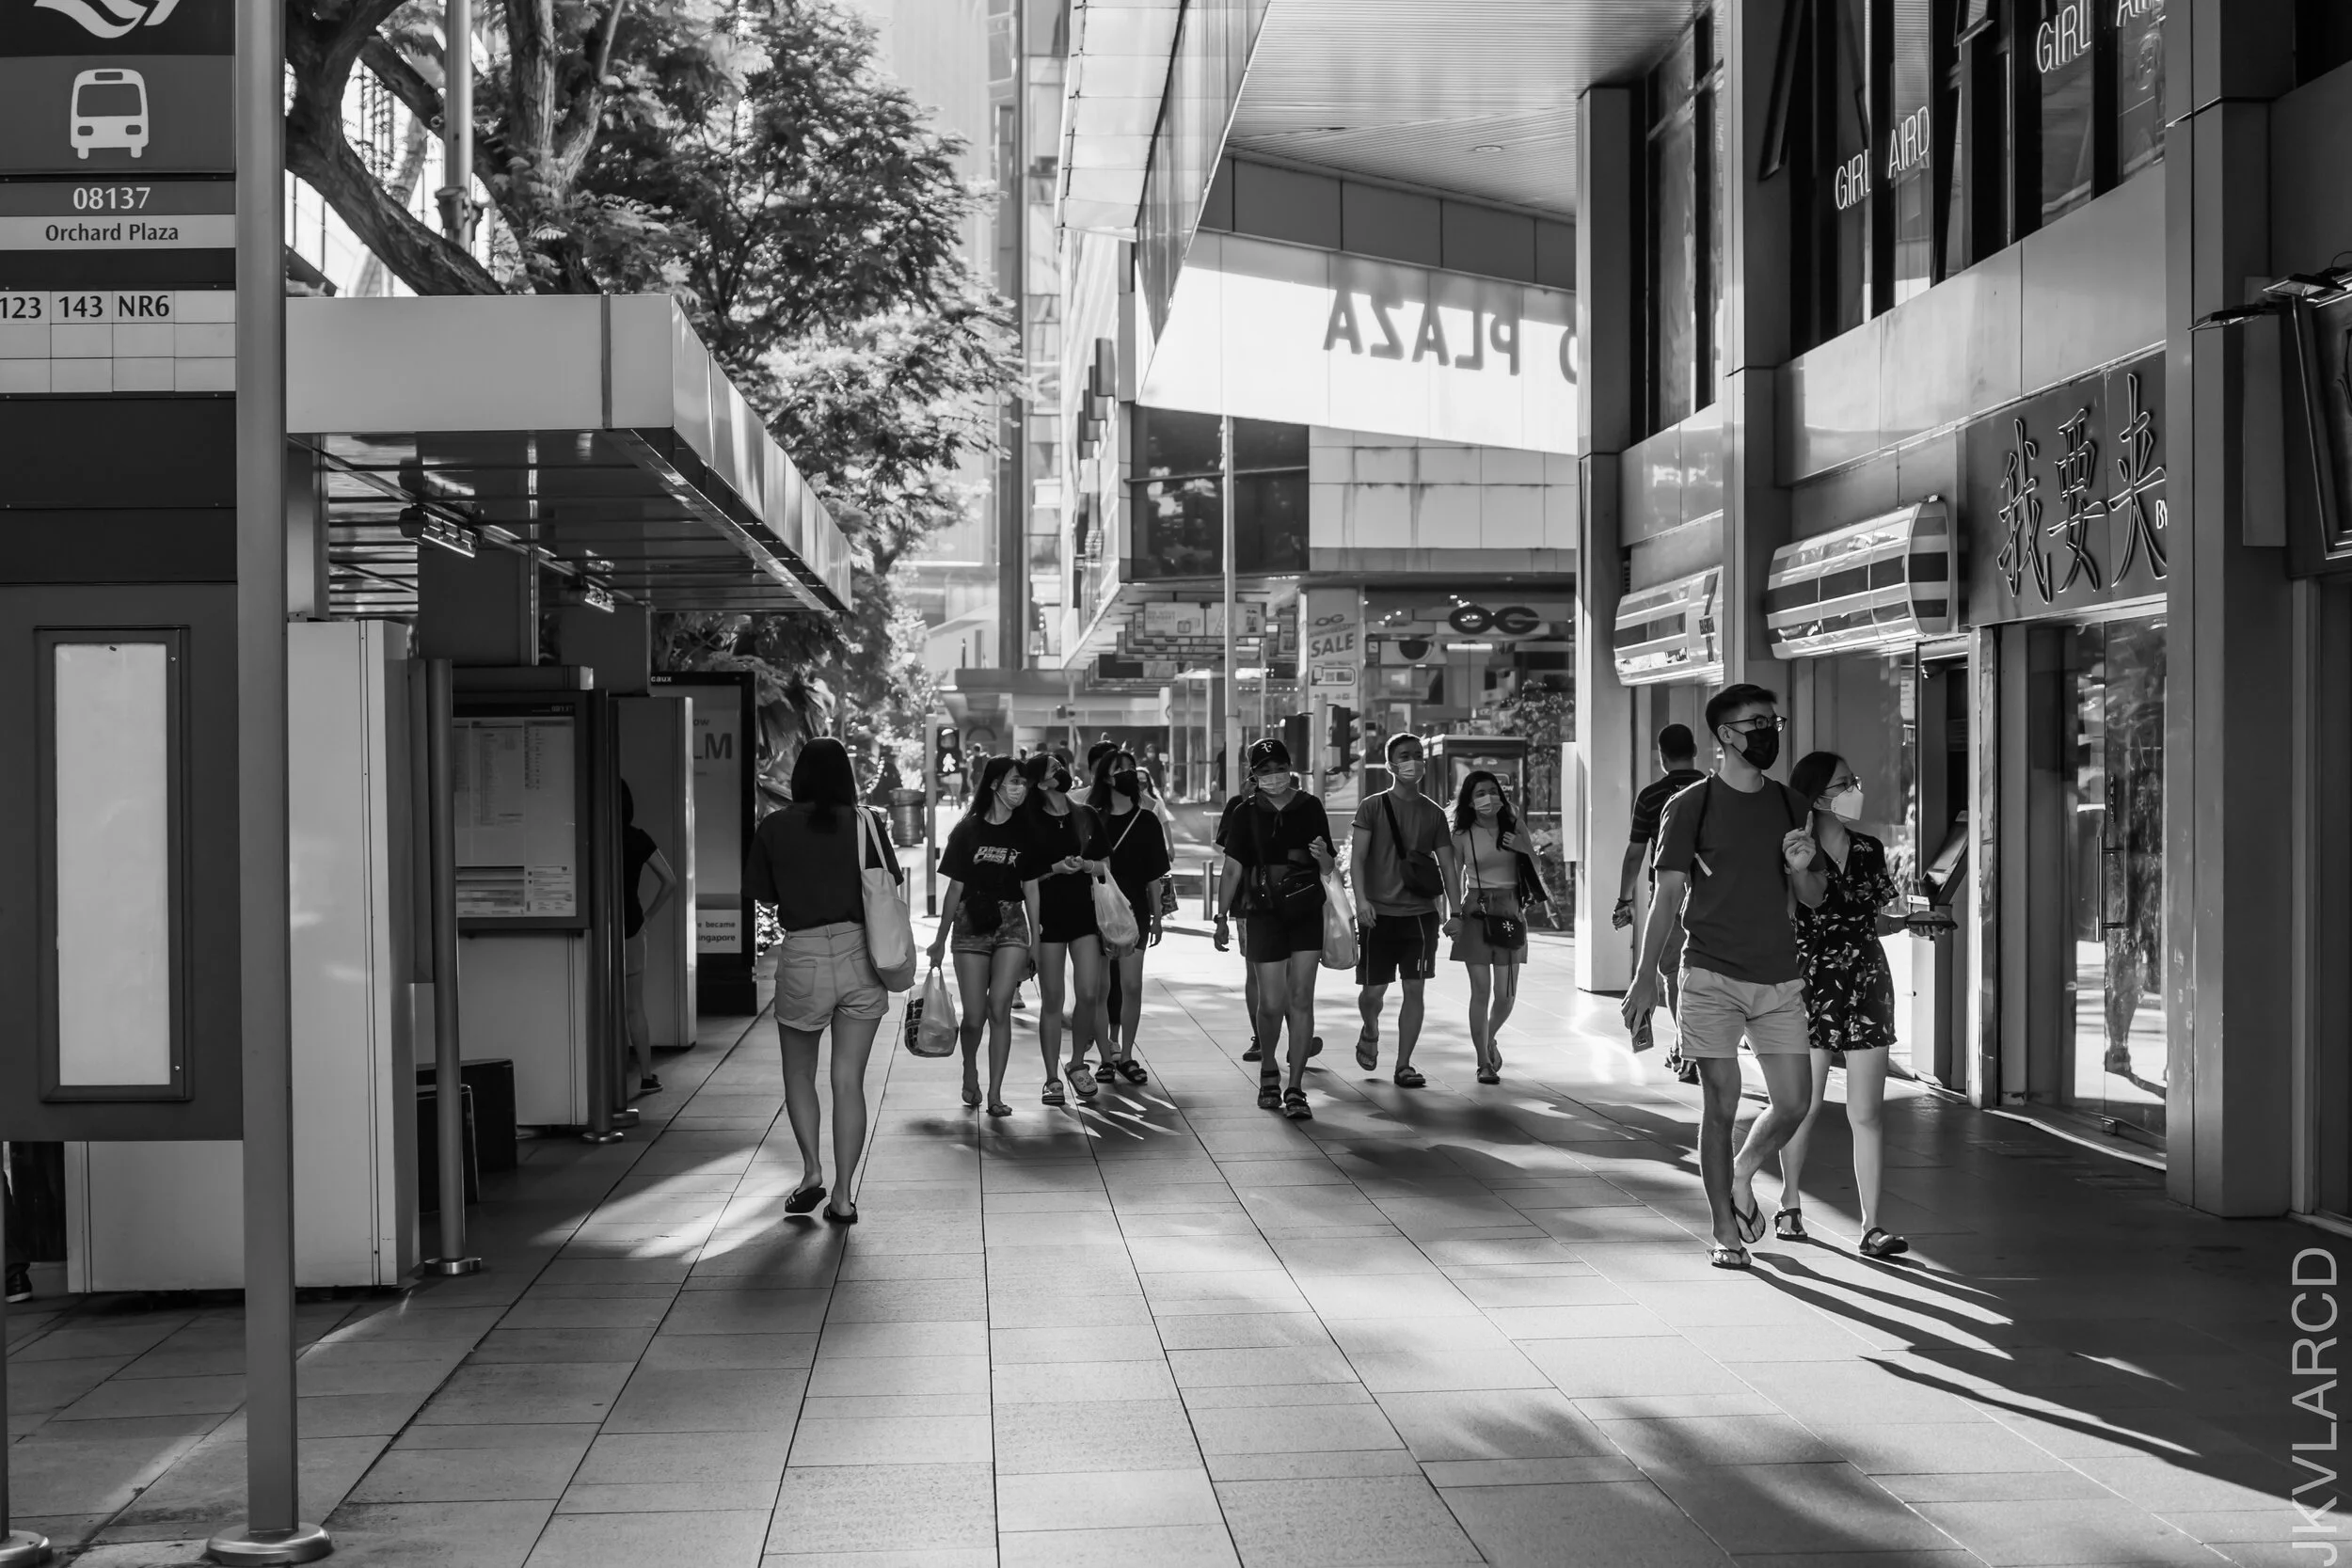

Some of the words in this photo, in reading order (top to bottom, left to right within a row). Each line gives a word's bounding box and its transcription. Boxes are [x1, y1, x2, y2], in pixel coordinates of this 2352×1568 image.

[1836, 149, 1871, 210] GIRL
[1887, 105, 1930, 179] AIRD
[72, 186, 151, 211] 08137
[44, 222, 121, 243] Orchard
[129, 222, 180, 242] Plaza
[0, 297, 42, 319] 123
[58, 296, 103, 318] 143
[118, 294, 169, 317] NR6
[1310, 632, 1355, 658] SALE
[697, 934, 737, 943] ingapore
